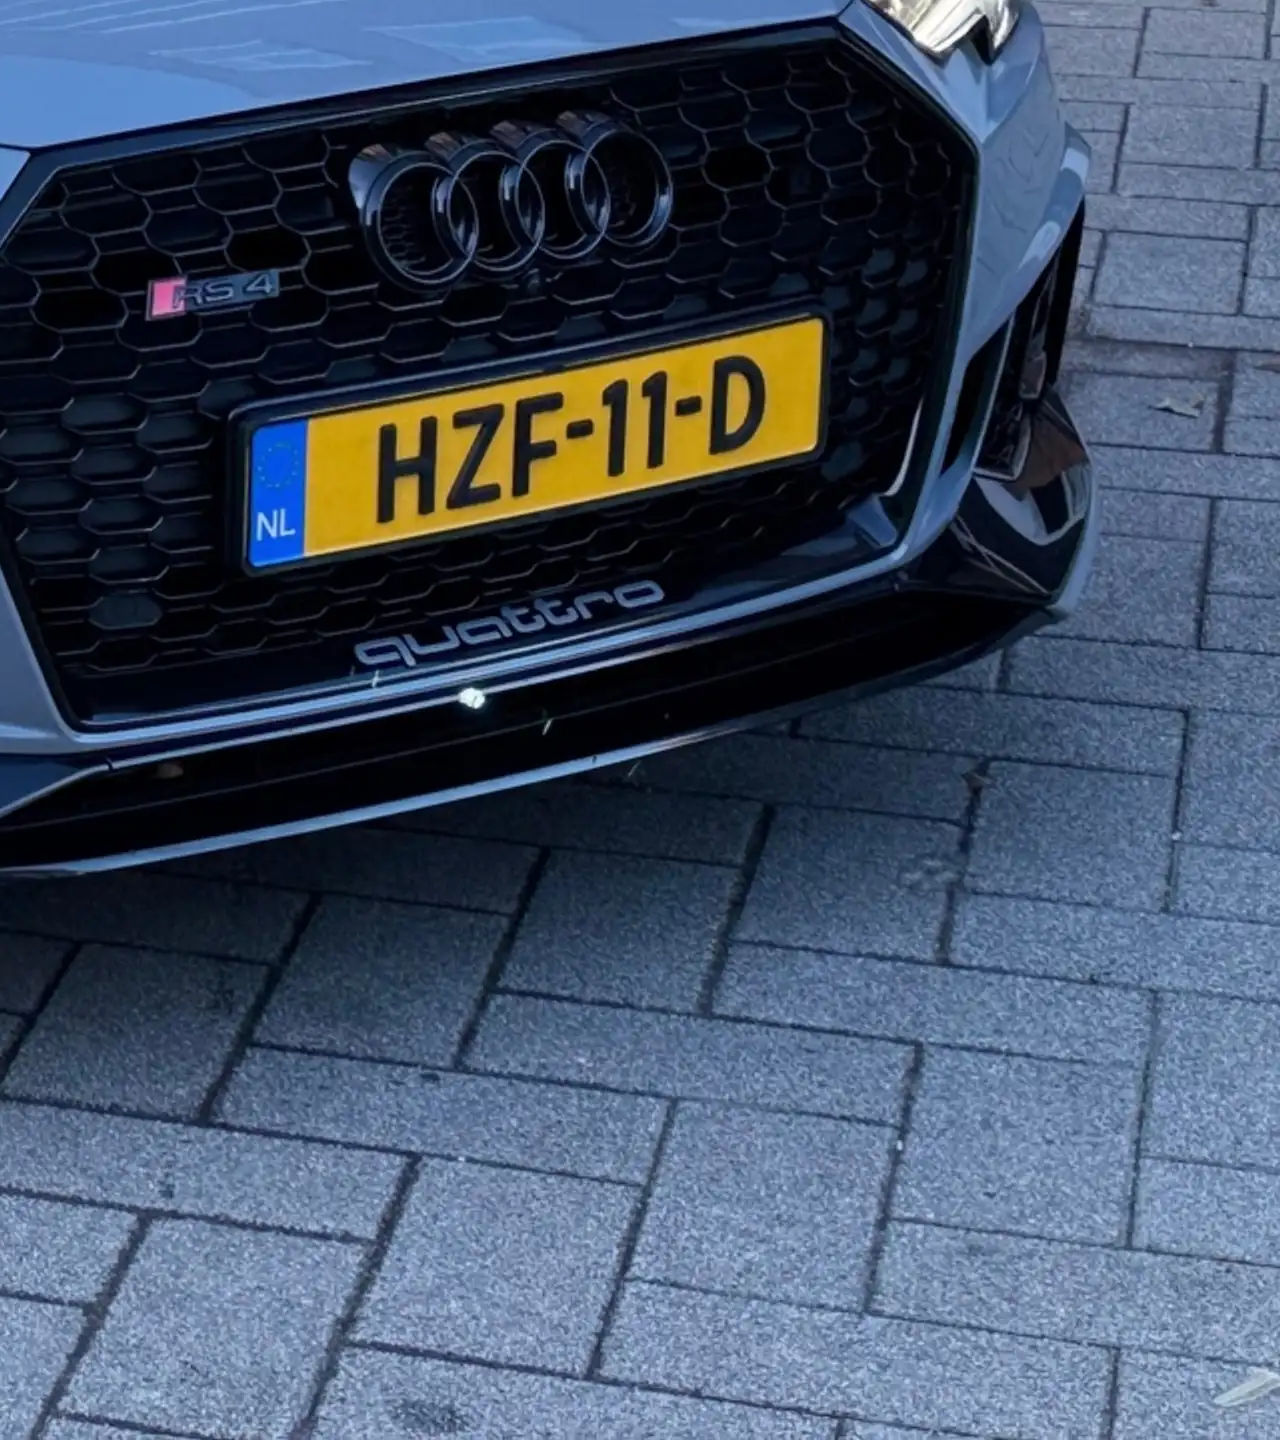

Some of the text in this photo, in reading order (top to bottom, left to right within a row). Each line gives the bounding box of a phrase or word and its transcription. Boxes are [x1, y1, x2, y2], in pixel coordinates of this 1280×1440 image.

[256, 355, 767, 541] NL HZF-11-D
[352, 578, 666, 668] quattro
